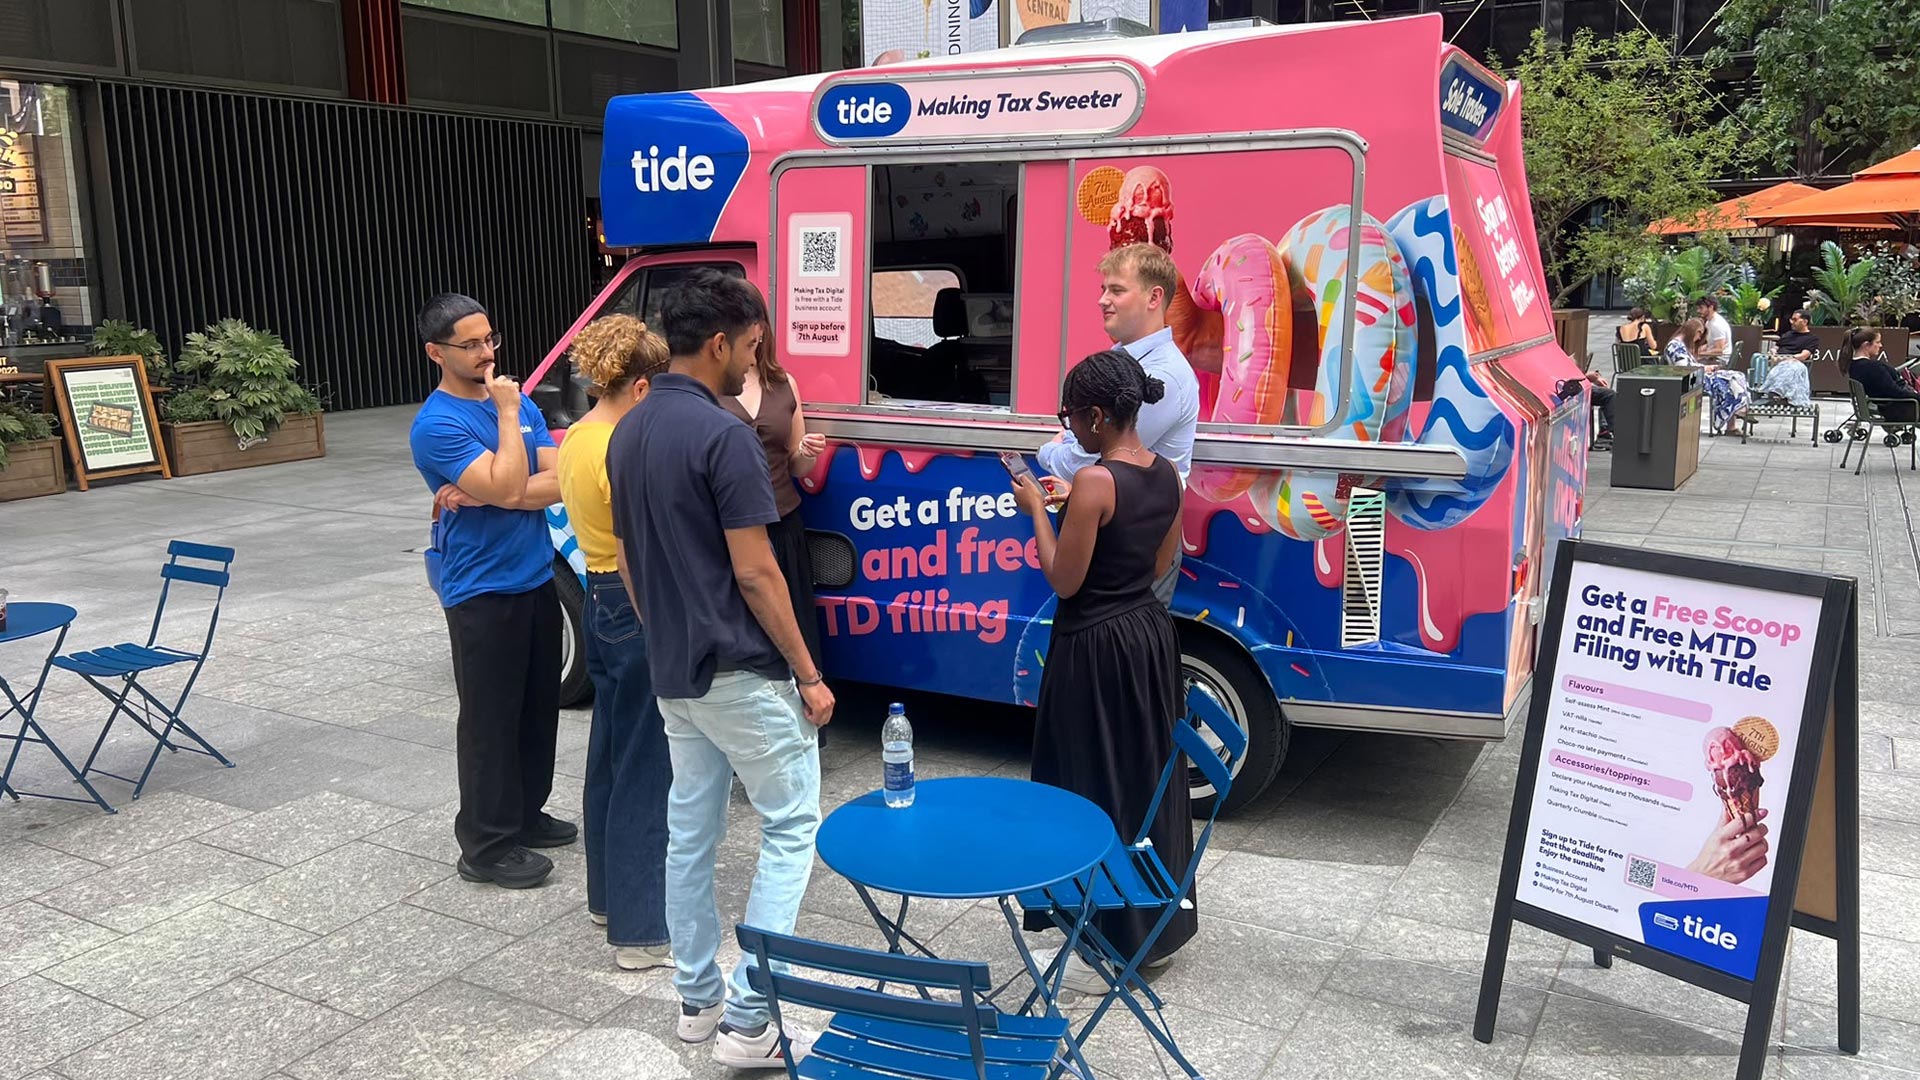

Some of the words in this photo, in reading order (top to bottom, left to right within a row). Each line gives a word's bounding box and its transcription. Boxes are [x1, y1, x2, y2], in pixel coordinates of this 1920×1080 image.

[1027, 0, 1065, 21] CENTRAL
[837, 97, 892, 125] tide
[917, 95, 991, 119] Making
[997, 93, 1032, 113] Tax
[1035, 89, 1122, 111] Sweeter
[1442, 78, 1465, 114] Sole
[1459, 86, 1487, 127] Traders
[631, 145, 715, 192] tide
[1094, 180, 1111, 195] 7th
[792, 322, 808, 332] Sign
[820, 322, 845, 330] before
[798, 333, 811, 341] 7th
[812, 333, 838, 343] August
[850, 496, 911, 531] Get
[917, 500, 938, 525] a
[946, 486, 1017, 522] free
[862, 529, 947, 581] and
[957, 527, 1041, 574] free
[815, 595, 880, 636] TD
[887, 588, 1009, 644] filing
[1582, 584, 1626, 612] Get
[1631, 598, 1647, 615] a
[1652, 596, 1708, 626] Free
[1712, 606, 1800, 647] Scoop
[1577, 614, 1625, 636] and
[1629, 618, 1684, 647] Free
[1689, 628, 1757, 660] MTD
[1573, 632, 1641, 671] Filing
[1647, 650, 1703, 678] with
[1710, 658, 1772, 691] Tide
[1568, 680, 1604, 694] Flavours
[1562, 711, 1588, 722] VAT-nilla
[1597, 704, 1610, 712] Mint
[1560, 724, 1598, 738] PAYE-stachio
[1749, 728, 1766, 742] 7TH
[1557, 738, 1584, 750] Choco-no
[1586, 745, 1596, 753] late
[1597, 750, 1626, 760] payments
[1555, 755, 1651, 786] Accessories/toppings:
[1549, 785, 1569, 796] Flaking
[1580, 793, 1599, 804] Digital
[1552, 772, 1572, 782] Declare
[1587, 782, 1614, 794] Hundreds
[1628, 792, 1660, 806] Thousands
[1546, 798, 1572, 812] Quarterly
[1573, 806, 1598, 818] Crumble
[1540, 838, 1558, 848] Beat
[1558, 843, 1570, 852] the
[1572, 848, 1604, 863] deadline
[1542, 828, 1558, 840] Sign
[1570, 837, 1578, 845] to
[1579, 840, 1595, 850] Tide
[1596, 845, 1607, 854] for
[1608, 849, 1624, 860] free
[1539, 846, 1558, 858] Enjoy
[1560, 852, 1572, 862] the
[1572, 858, 1606, 872] sunshine
[1540, 872, 1560, 884] Making
[1570, 882, 1588, 892] Digital
[1542, 864, 1564, 876] Business
[1564, 870, 1588, 882] Account
[1662, 876, 1699, 893] tide.co/MTD
[1539, 882, 1556, 894] Ready
[1574, 894, 1594, 906] August
[1594, 900, 1620, 914] Deadline
[1683, 914, 1738, 950] tide
